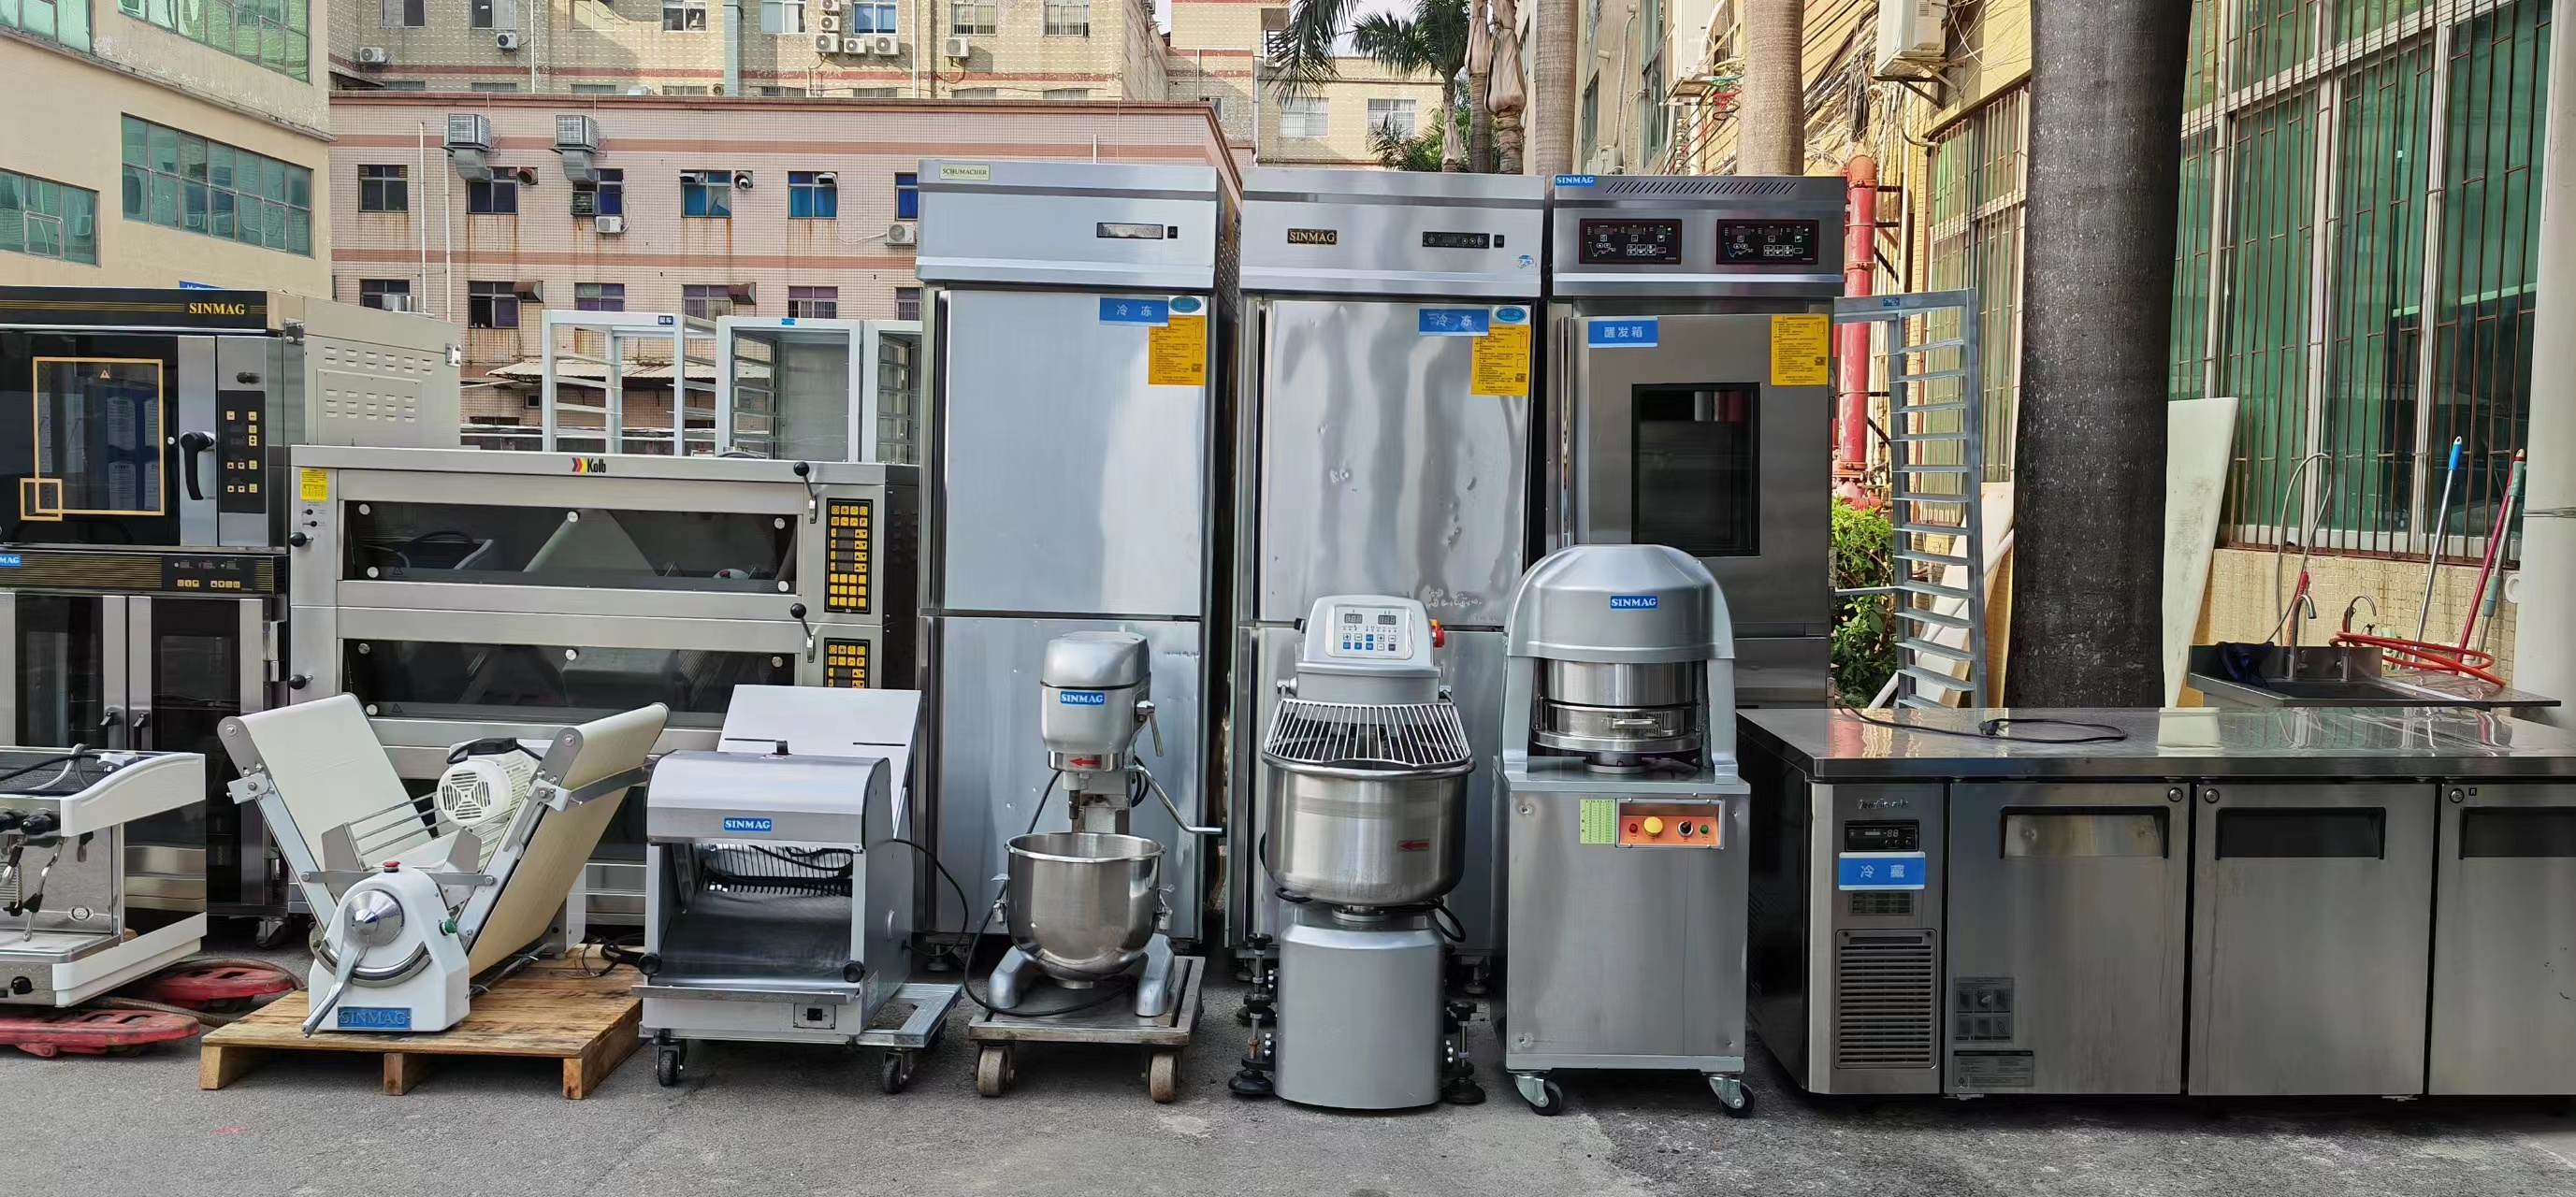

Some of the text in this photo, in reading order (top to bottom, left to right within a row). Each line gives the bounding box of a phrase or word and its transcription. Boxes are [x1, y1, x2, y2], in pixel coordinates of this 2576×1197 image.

[1290, 232, 1335, 242] SINMAG
[189, 302, 245, 314] SINMAG
[1116, 304, 1152, 317] 冷冻
[1603, 325, 1643, 339] 醒发箱
[586, 457, 607, 473] Kolb
[1611, 598, 1657, 607] SINMAG
[1061, 693, 1104, 703] SINMAG
[724, 819, 771, 829] SINMAG
[1860, 864, 1905, 879] 冷藏
[340, 1010, 407, 1025] SINMAG
